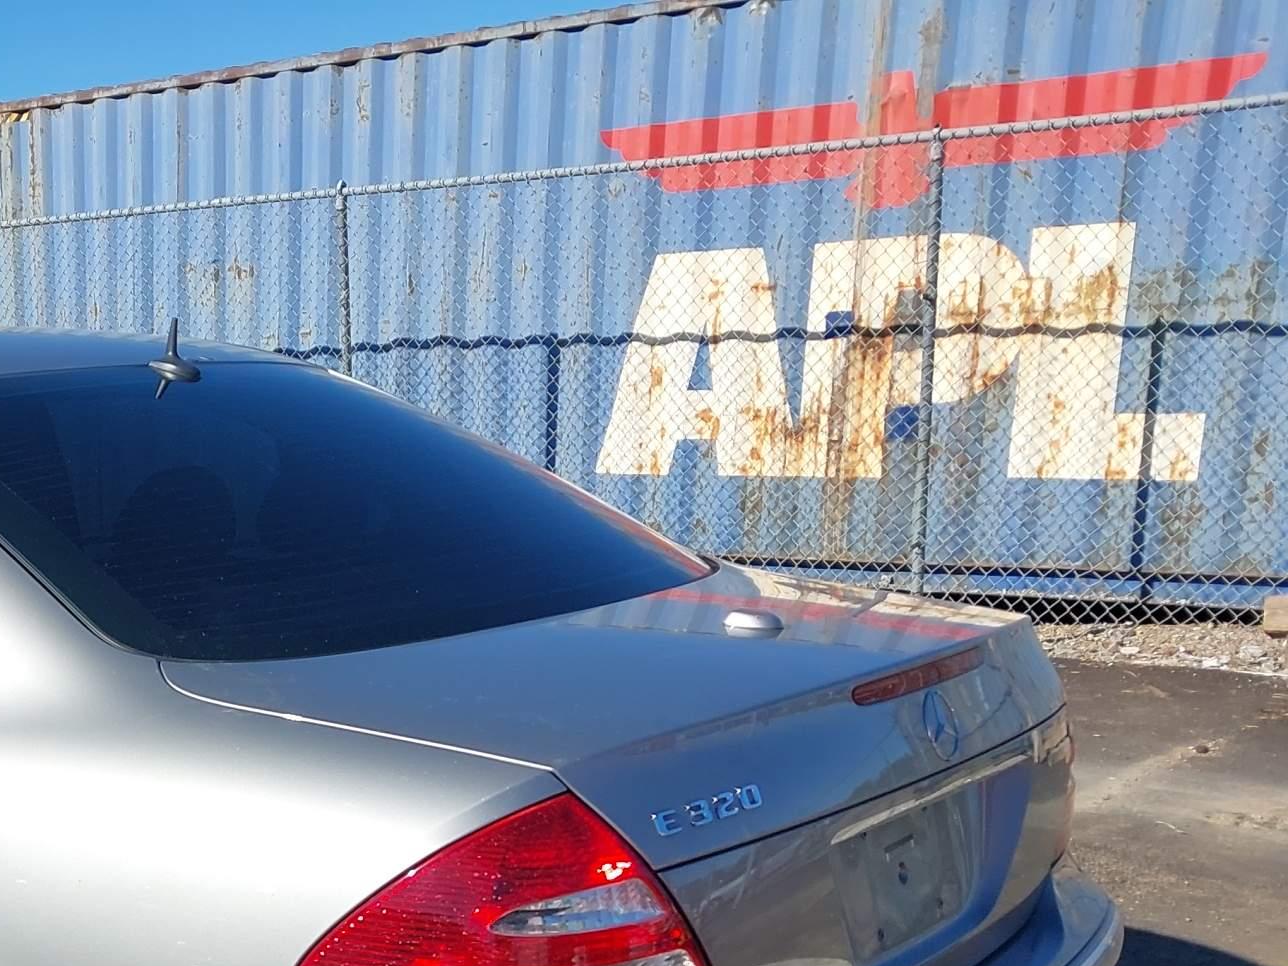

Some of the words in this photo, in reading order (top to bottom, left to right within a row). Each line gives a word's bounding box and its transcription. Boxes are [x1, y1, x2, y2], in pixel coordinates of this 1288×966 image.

[596, 222, 1206, 482] APL
[651, 809, 682, 837] E
[684, 784, 763, 827] 320
